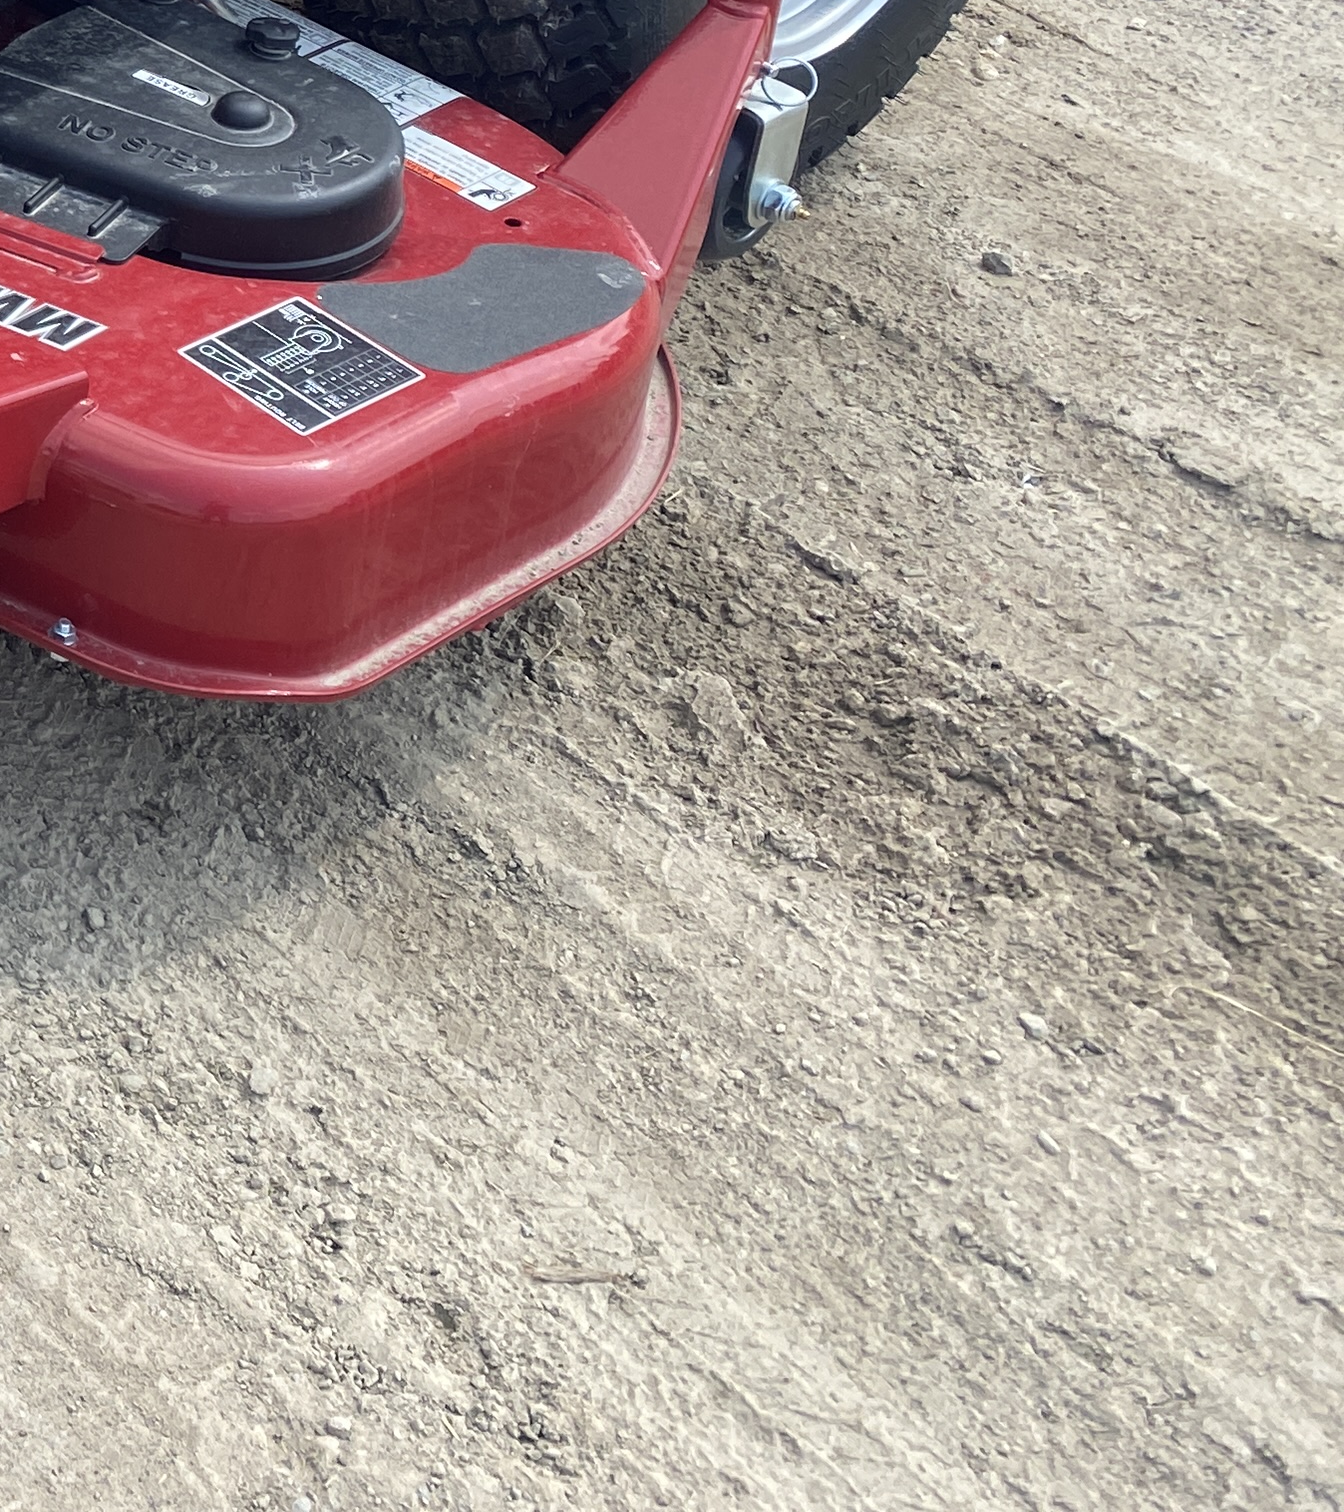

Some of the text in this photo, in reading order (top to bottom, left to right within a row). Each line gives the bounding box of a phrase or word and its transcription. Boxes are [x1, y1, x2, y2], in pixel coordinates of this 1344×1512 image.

[146, 75, 198, 101] GREASE
[58, 113, 219, 173] NO STEP
